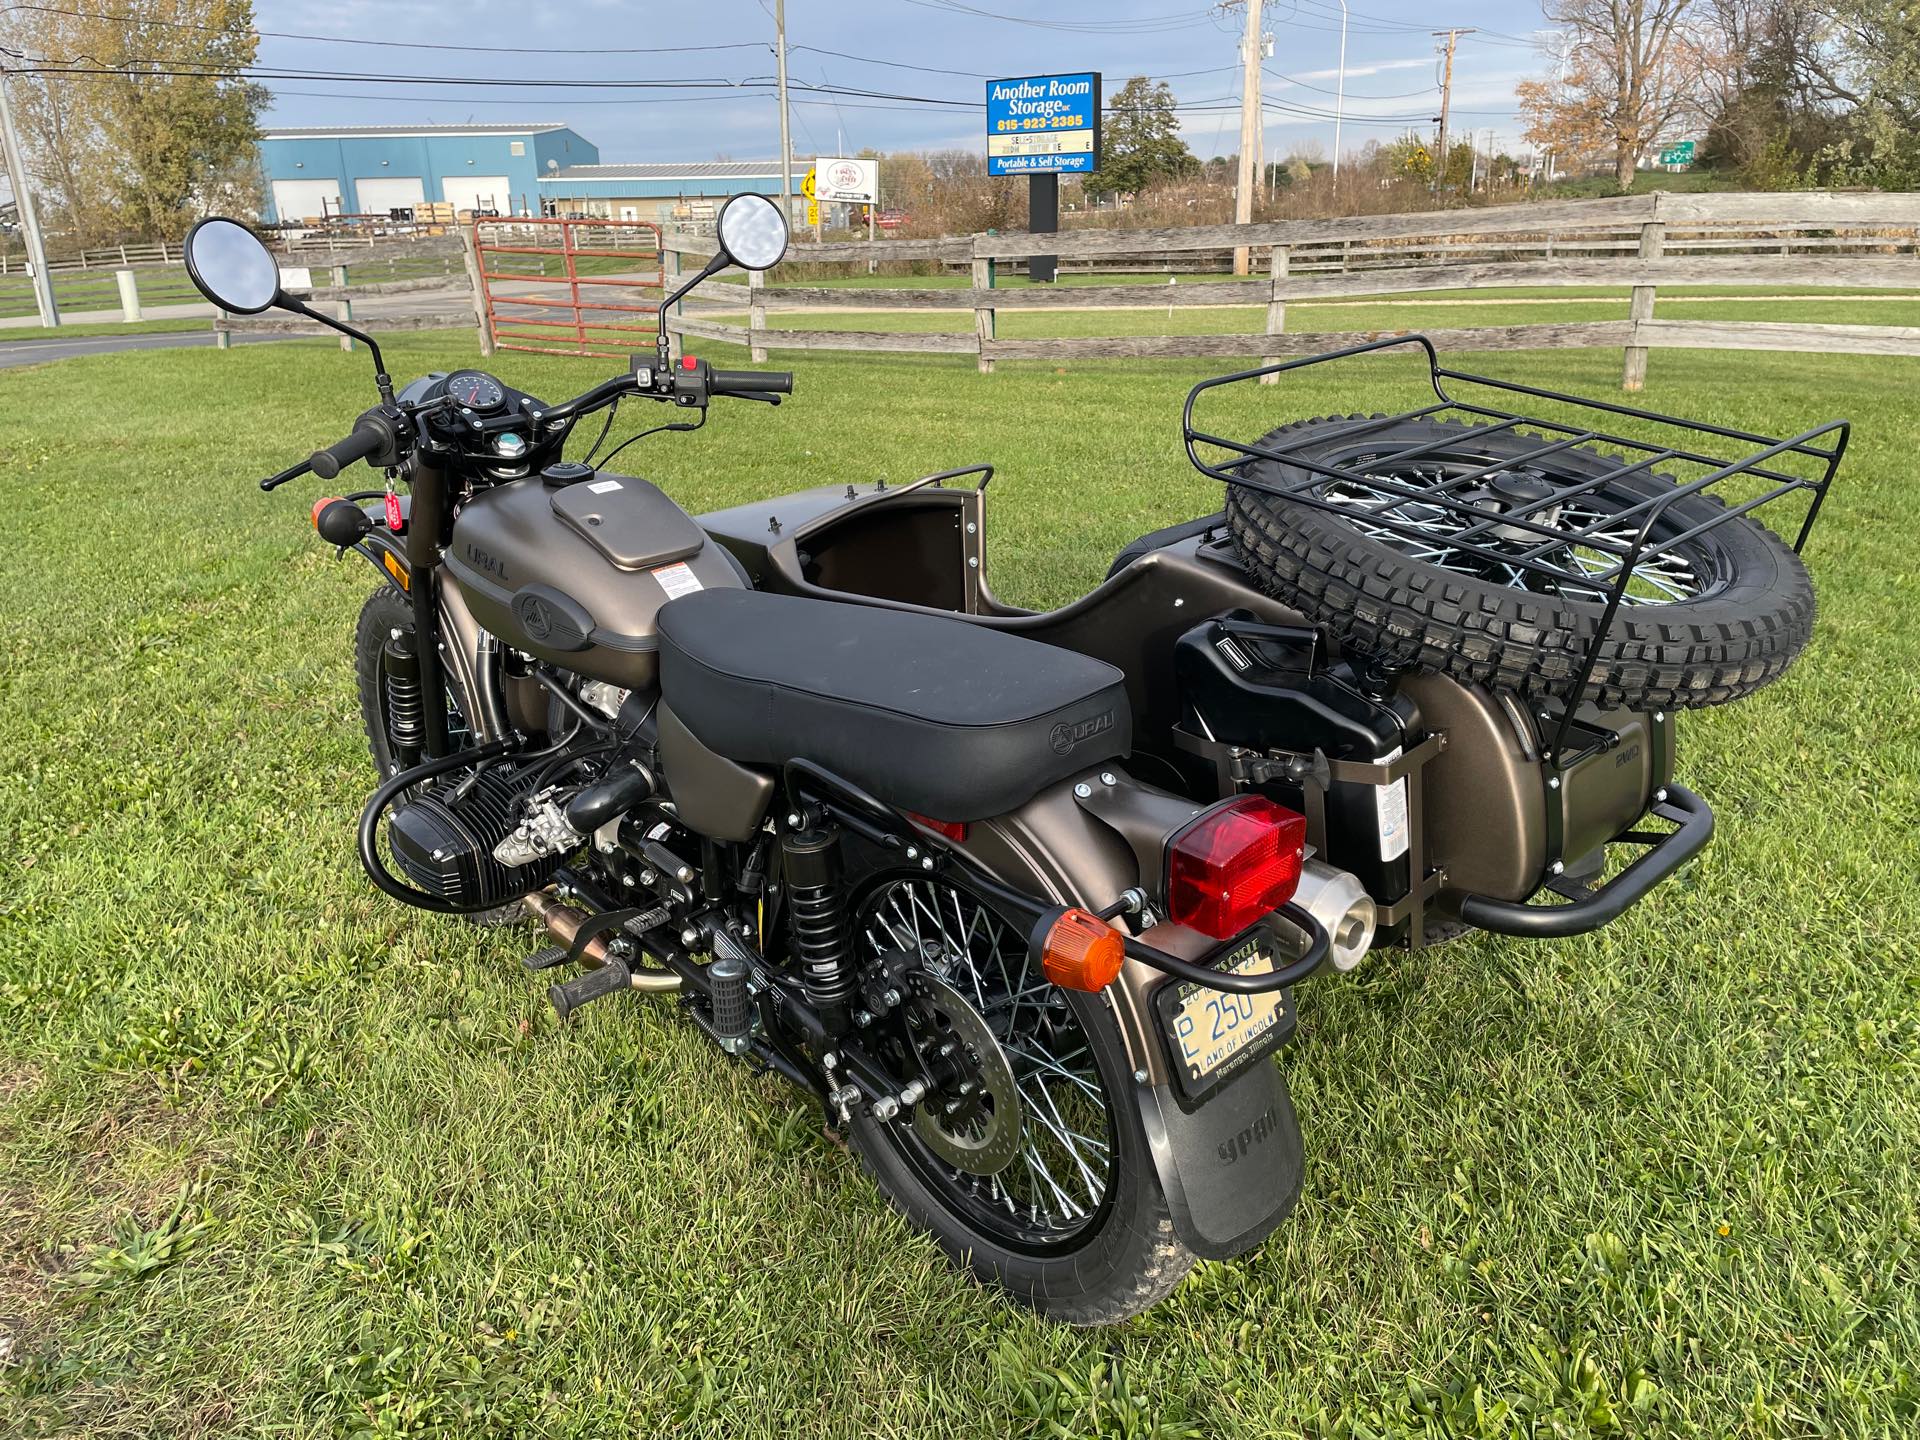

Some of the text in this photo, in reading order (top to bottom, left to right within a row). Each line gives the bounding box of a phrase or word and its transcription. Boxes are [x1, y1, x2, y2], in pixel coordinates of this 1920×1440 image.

[991, 80, 1090, 101] Another Room
[1008, 99, 1062, 118] Storage
[997, 115, 1084, 131] 815-923-2385
[997, 155, 1085, 169] Portable & Self Storage
[466, 543, 509, 582] URAL
[1074, 714, 1113, 739] URAL
[1615, 744, 1640, 769] 2WD
[1205, 992, 1253, 1042] 250
[1200, 1013, 1275, 1072] LAND OF LINCOLN
[1215, 1032, 1274, 1079] Marengo, Illinois
